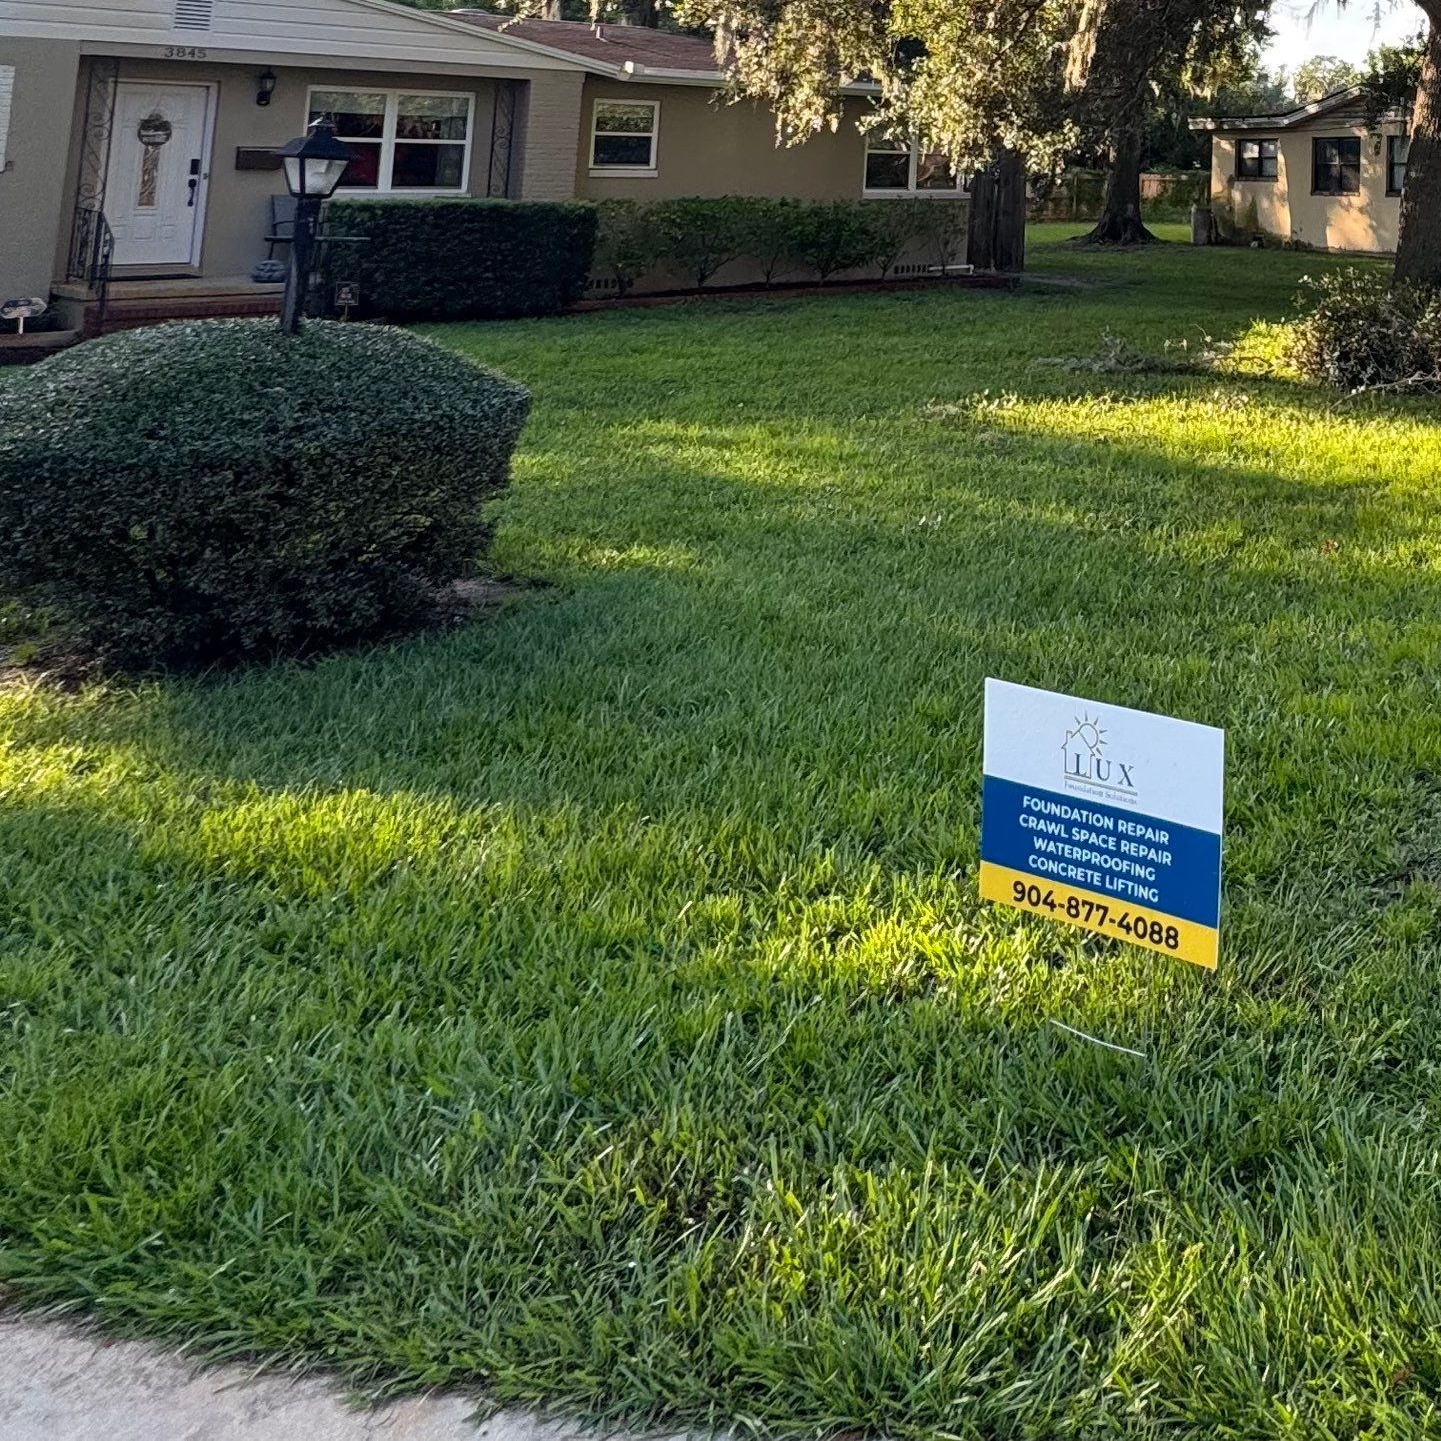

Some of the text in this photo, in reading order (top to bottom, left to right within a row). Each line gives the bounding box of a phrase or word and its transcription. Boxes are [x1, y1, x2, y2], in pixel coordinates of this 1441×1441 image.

[164, 47, 207, 59] 3845
[1074, 753, 1134, 787] LUX
[1019, 813, 1172, 866] CRAWL SPACE REPAIR
[1022, 795, 1169, 845] FOUNDATION REPAIR
[1028, 855, 1159, 903] CONCRETE LIFTING
[1033, 836, 1156, 881] WATERPROOFING
[1012, 880, 1179, 950] 904-877-4088
